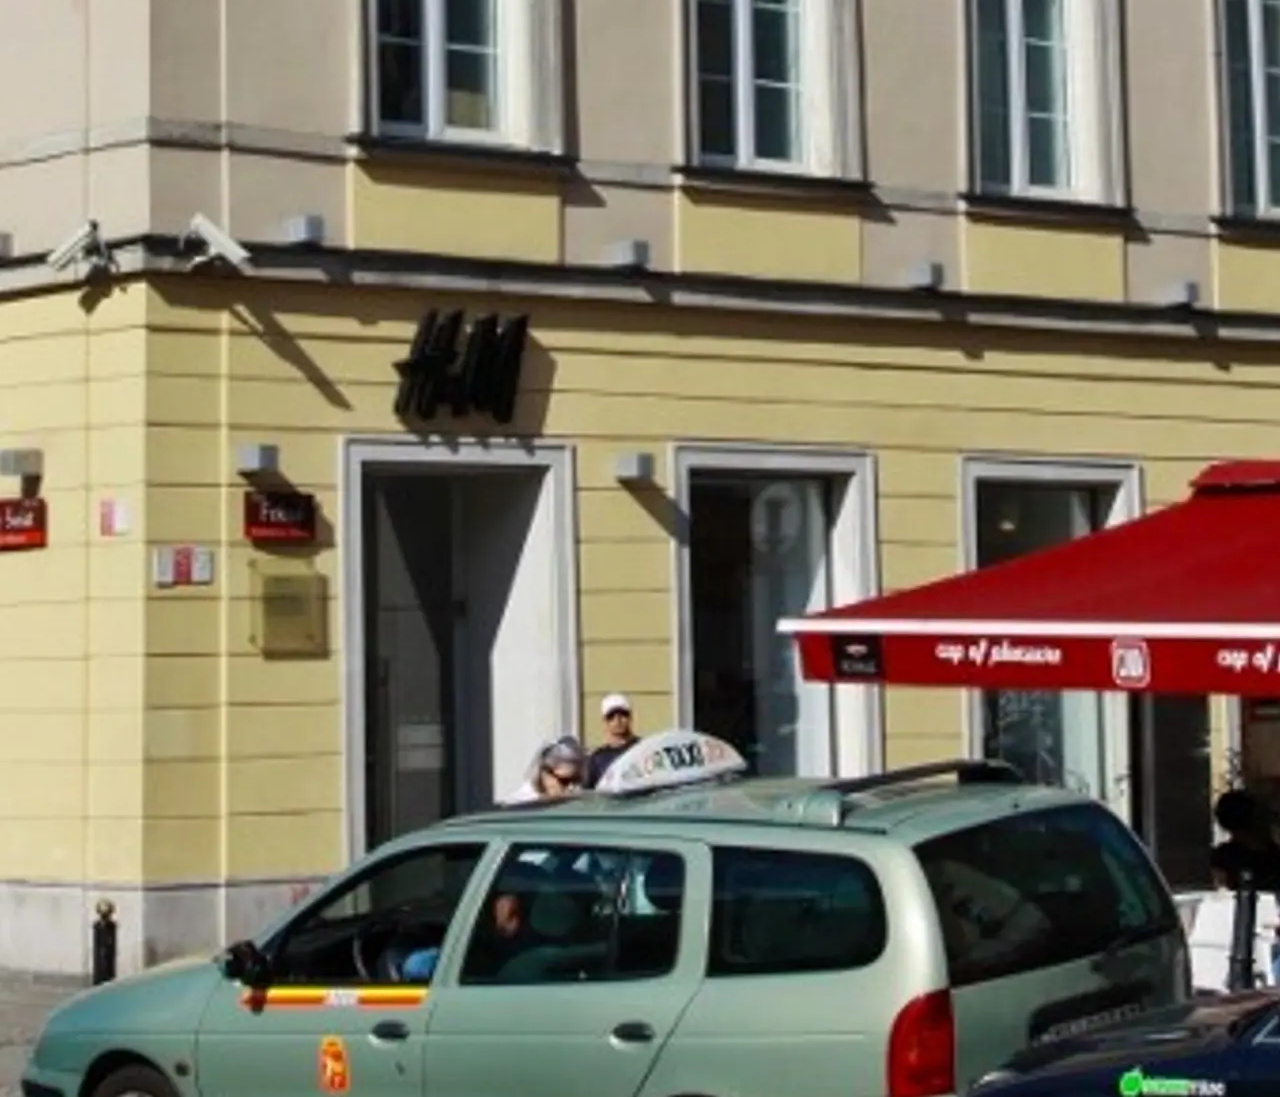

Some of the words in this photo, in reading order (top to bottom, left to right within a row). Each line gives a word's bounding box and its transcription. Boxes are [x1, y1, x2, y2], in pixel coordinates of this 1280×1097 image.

[935, 642, 964, 666] cup
[968, 638, 988, 666] of
[987, 639, 1062, 667] pleasure
[1217, 648, 1248, 673] cup
[1252, 643, 1275, 673] of
[663, 740, 706, 771] TAXI
